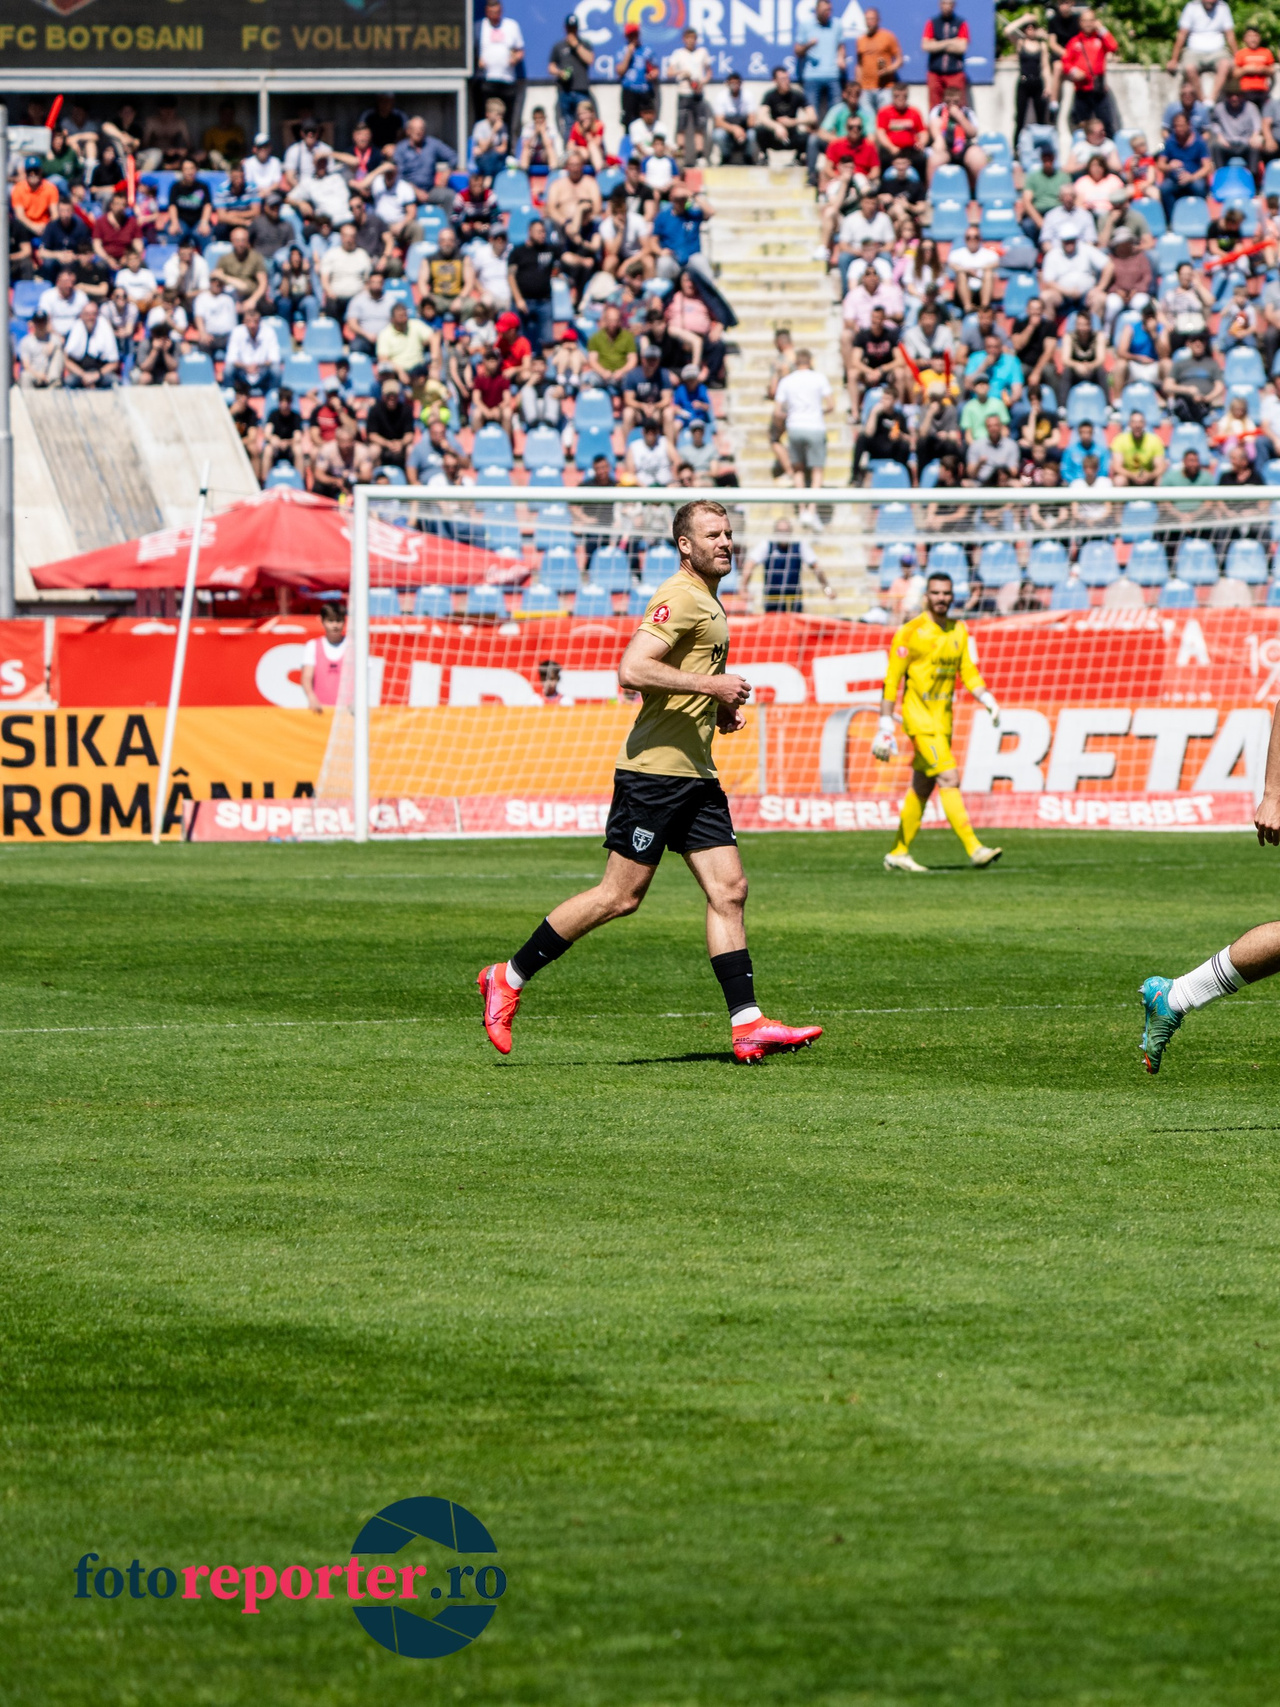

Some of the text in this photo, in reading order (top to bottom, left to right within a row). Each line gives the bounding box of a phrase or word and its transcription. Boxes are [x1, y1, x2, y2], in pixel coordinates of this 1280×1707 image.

[0, 25, 204, 50] FC BOTOSANI
[242, 25, 461, 50] FC VOLUNTARI
[1, 714, 160, 768] SIKA
[215, 799, 426, 834] SUPERLGA
[1037, 796, 1214, 827] SUPERBET
